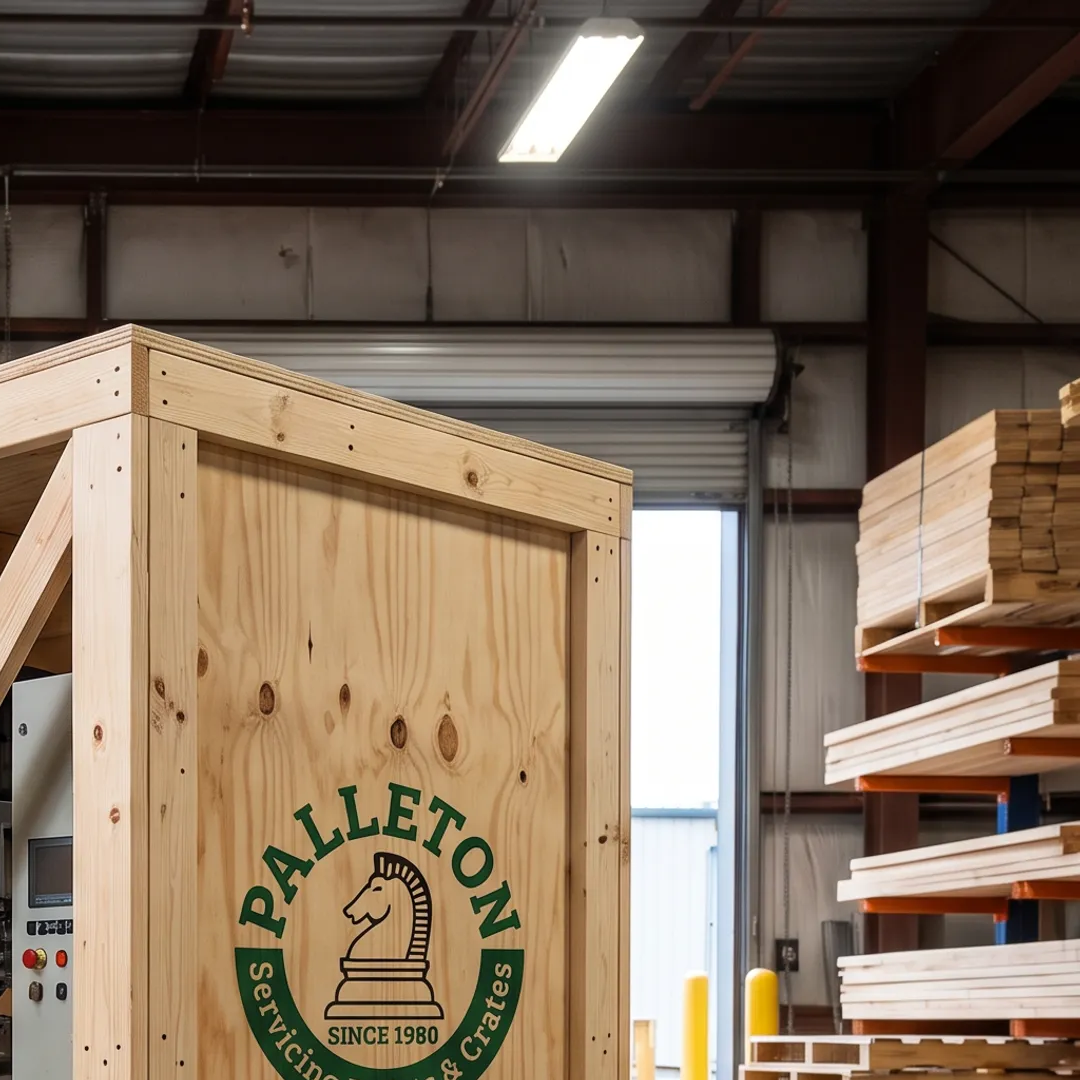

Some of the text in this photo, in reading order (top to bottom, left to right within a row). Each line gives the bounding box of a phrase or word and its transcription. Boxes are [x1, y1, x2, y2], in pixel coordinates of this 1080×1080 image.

[239, 782, 521, 939] PALLETON
[328, 1026, 438, 1045] SINCE 1980
[460, 962, 512, 1061] Crates
